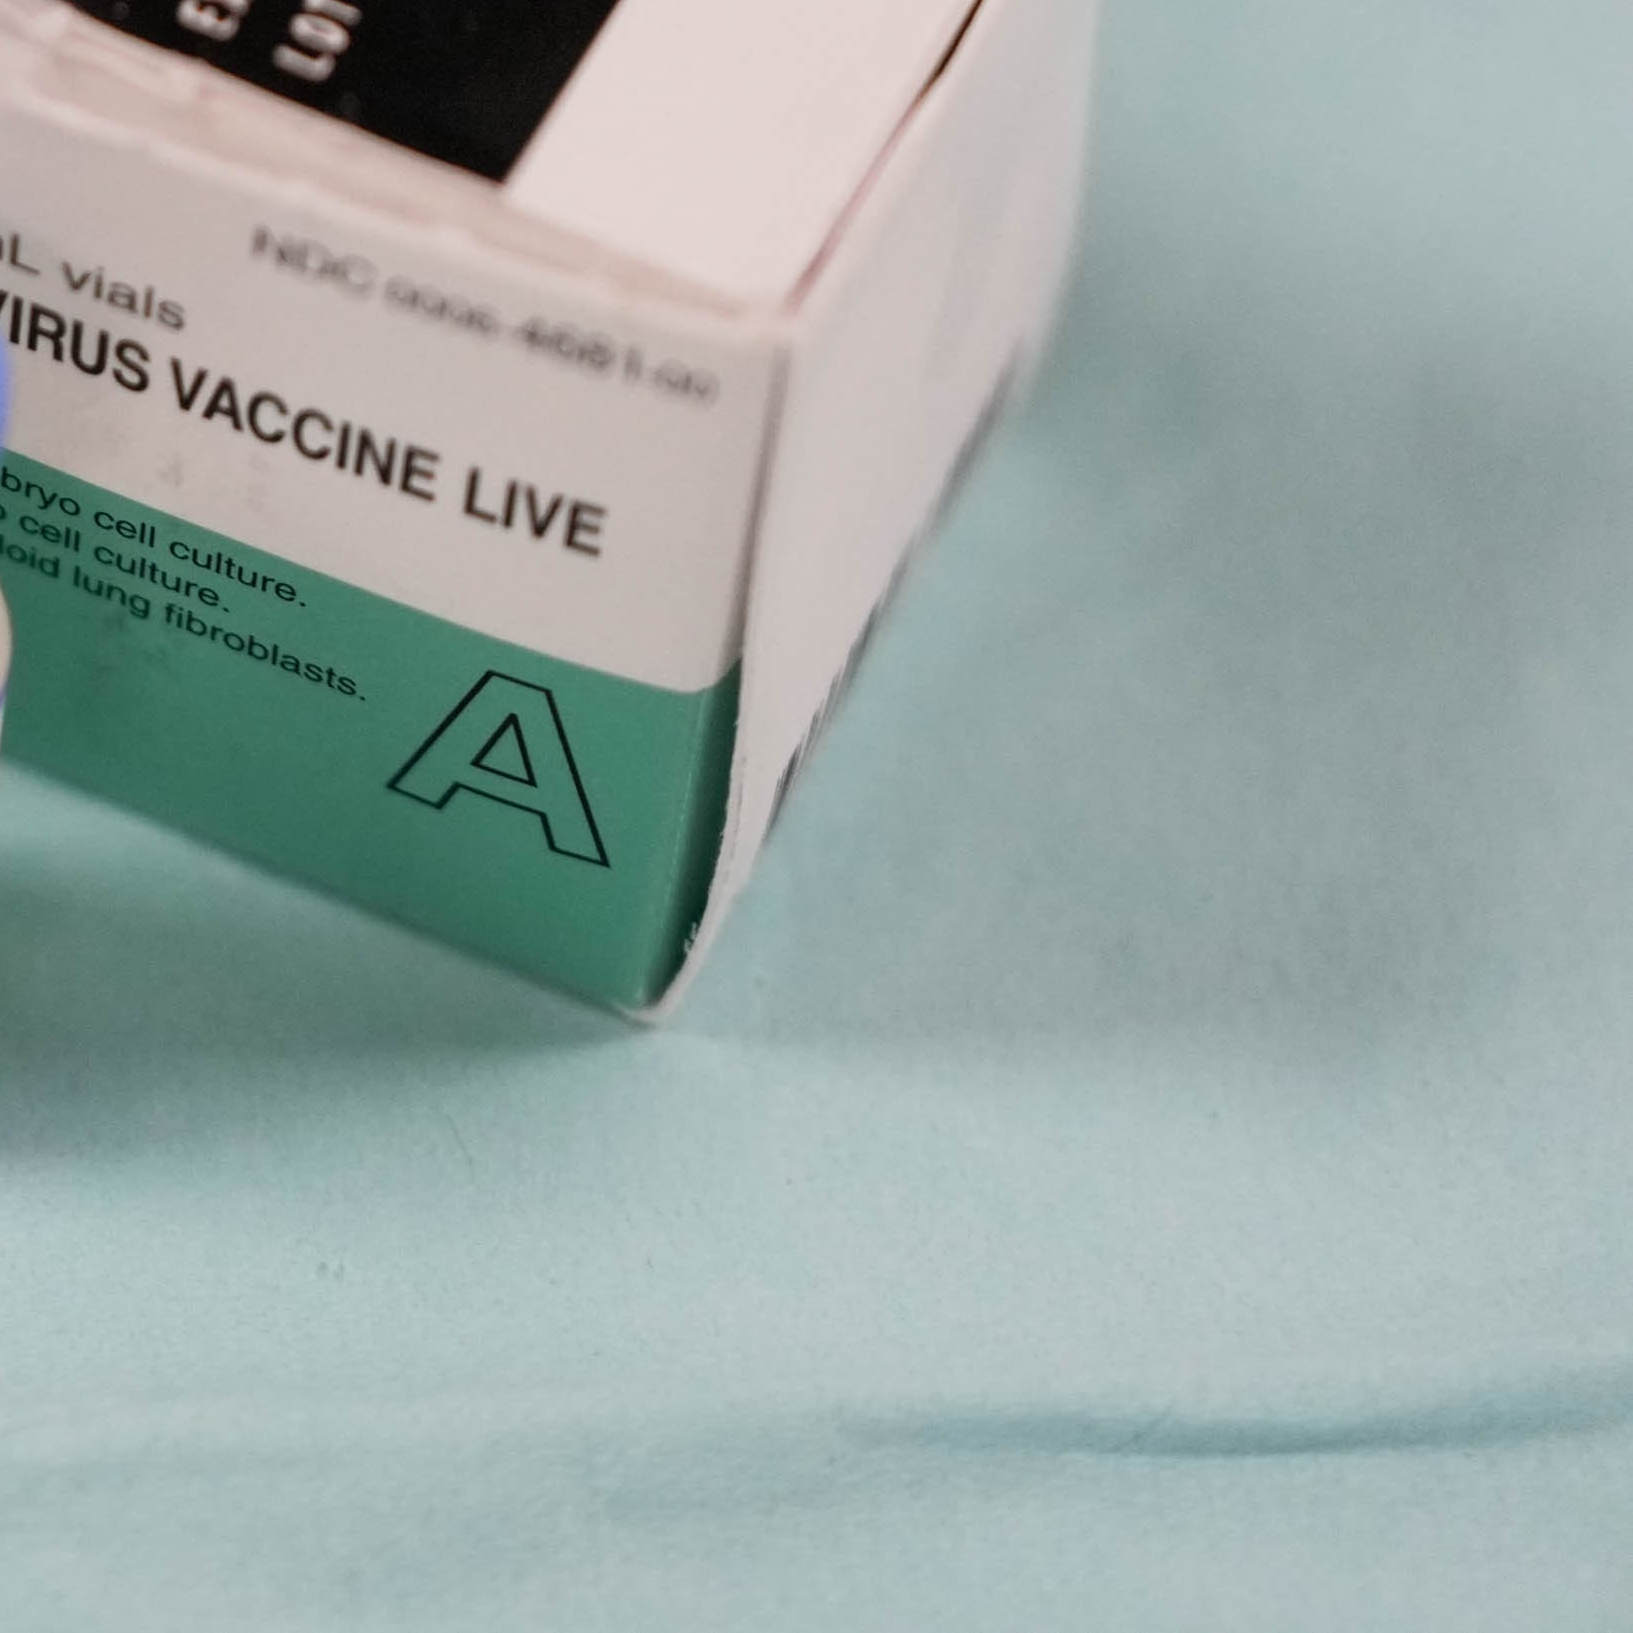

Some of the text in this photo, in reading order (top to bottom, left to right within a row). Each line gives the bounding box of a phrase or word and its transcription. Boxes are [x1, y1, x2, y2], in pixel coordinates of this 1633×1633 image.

[61, 259, 186, 332] vials
[169, 355, 442, 505] VACCINE
[463, 465, 608, 558] LIVE
[19, 514, 81, 553] cell
[92, 543, 230, 614] culture.
[93, 509, 156, 549] cell
[168, 540, 307, 608] culture.
[72, 565, 152, 621] lung
[164, 602, 367, 703] fibroblasts.
[385, 667, 612, 869] A
